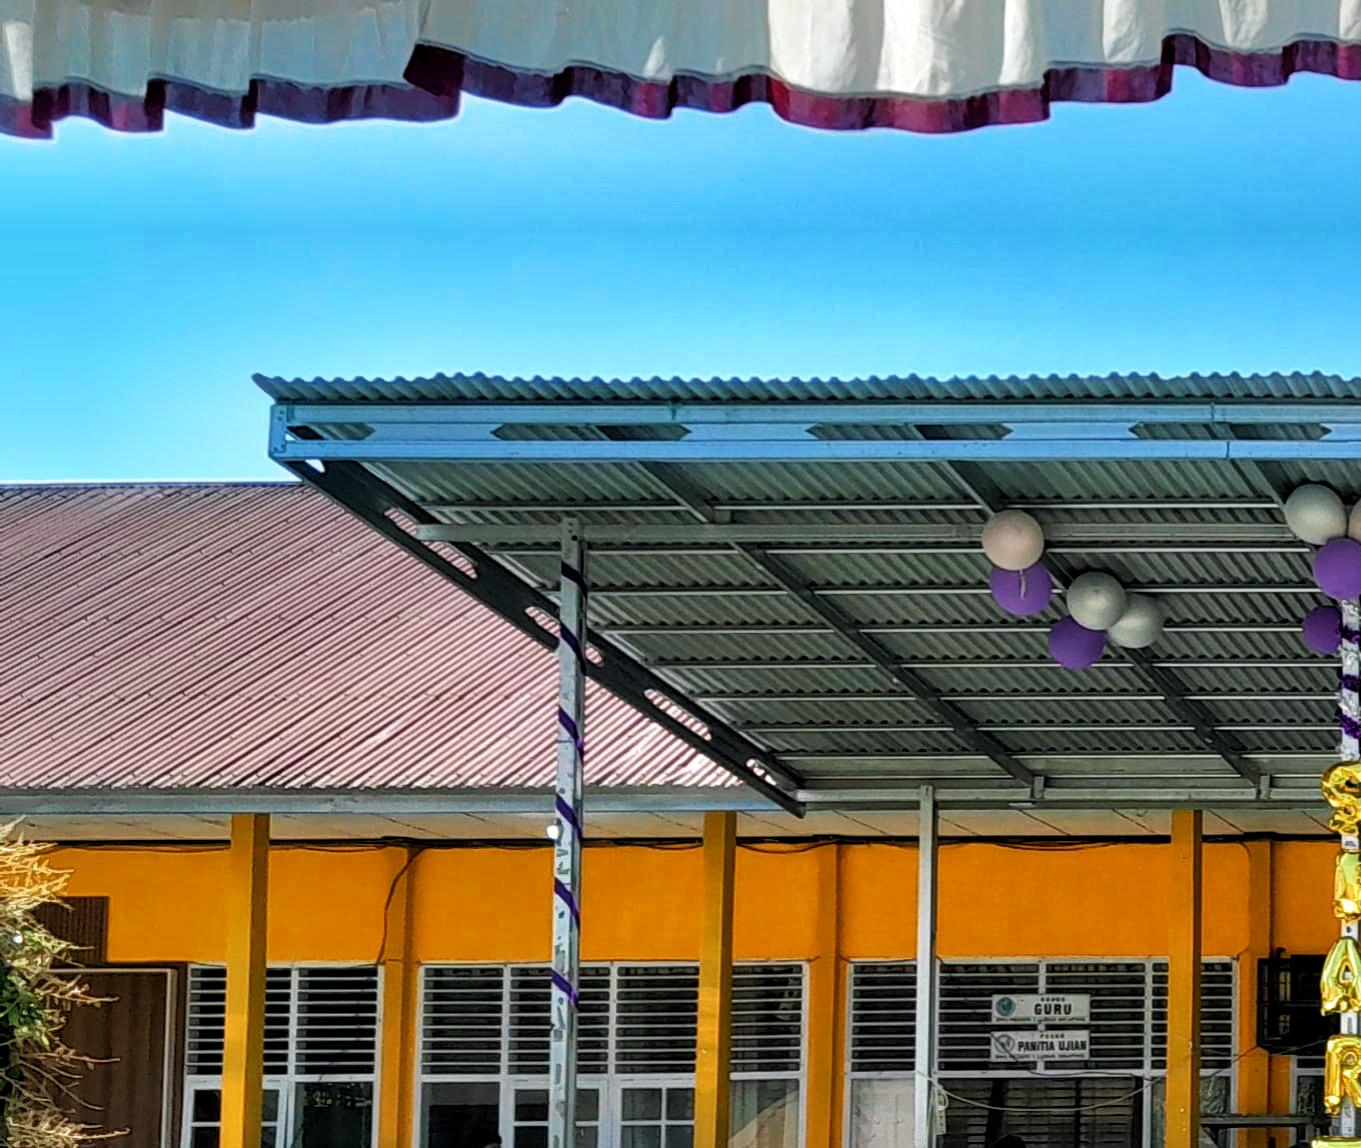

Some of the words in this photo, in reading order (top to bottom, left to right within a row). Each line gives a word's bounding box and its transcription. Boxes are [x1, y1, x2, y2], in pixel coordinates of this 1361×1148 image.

[1034, 1003, 1072, 1015] GURU
[1018, 1041, 1055, 1053] PANITIA
[1058, 1040, 1086, 1052] UJIAN
